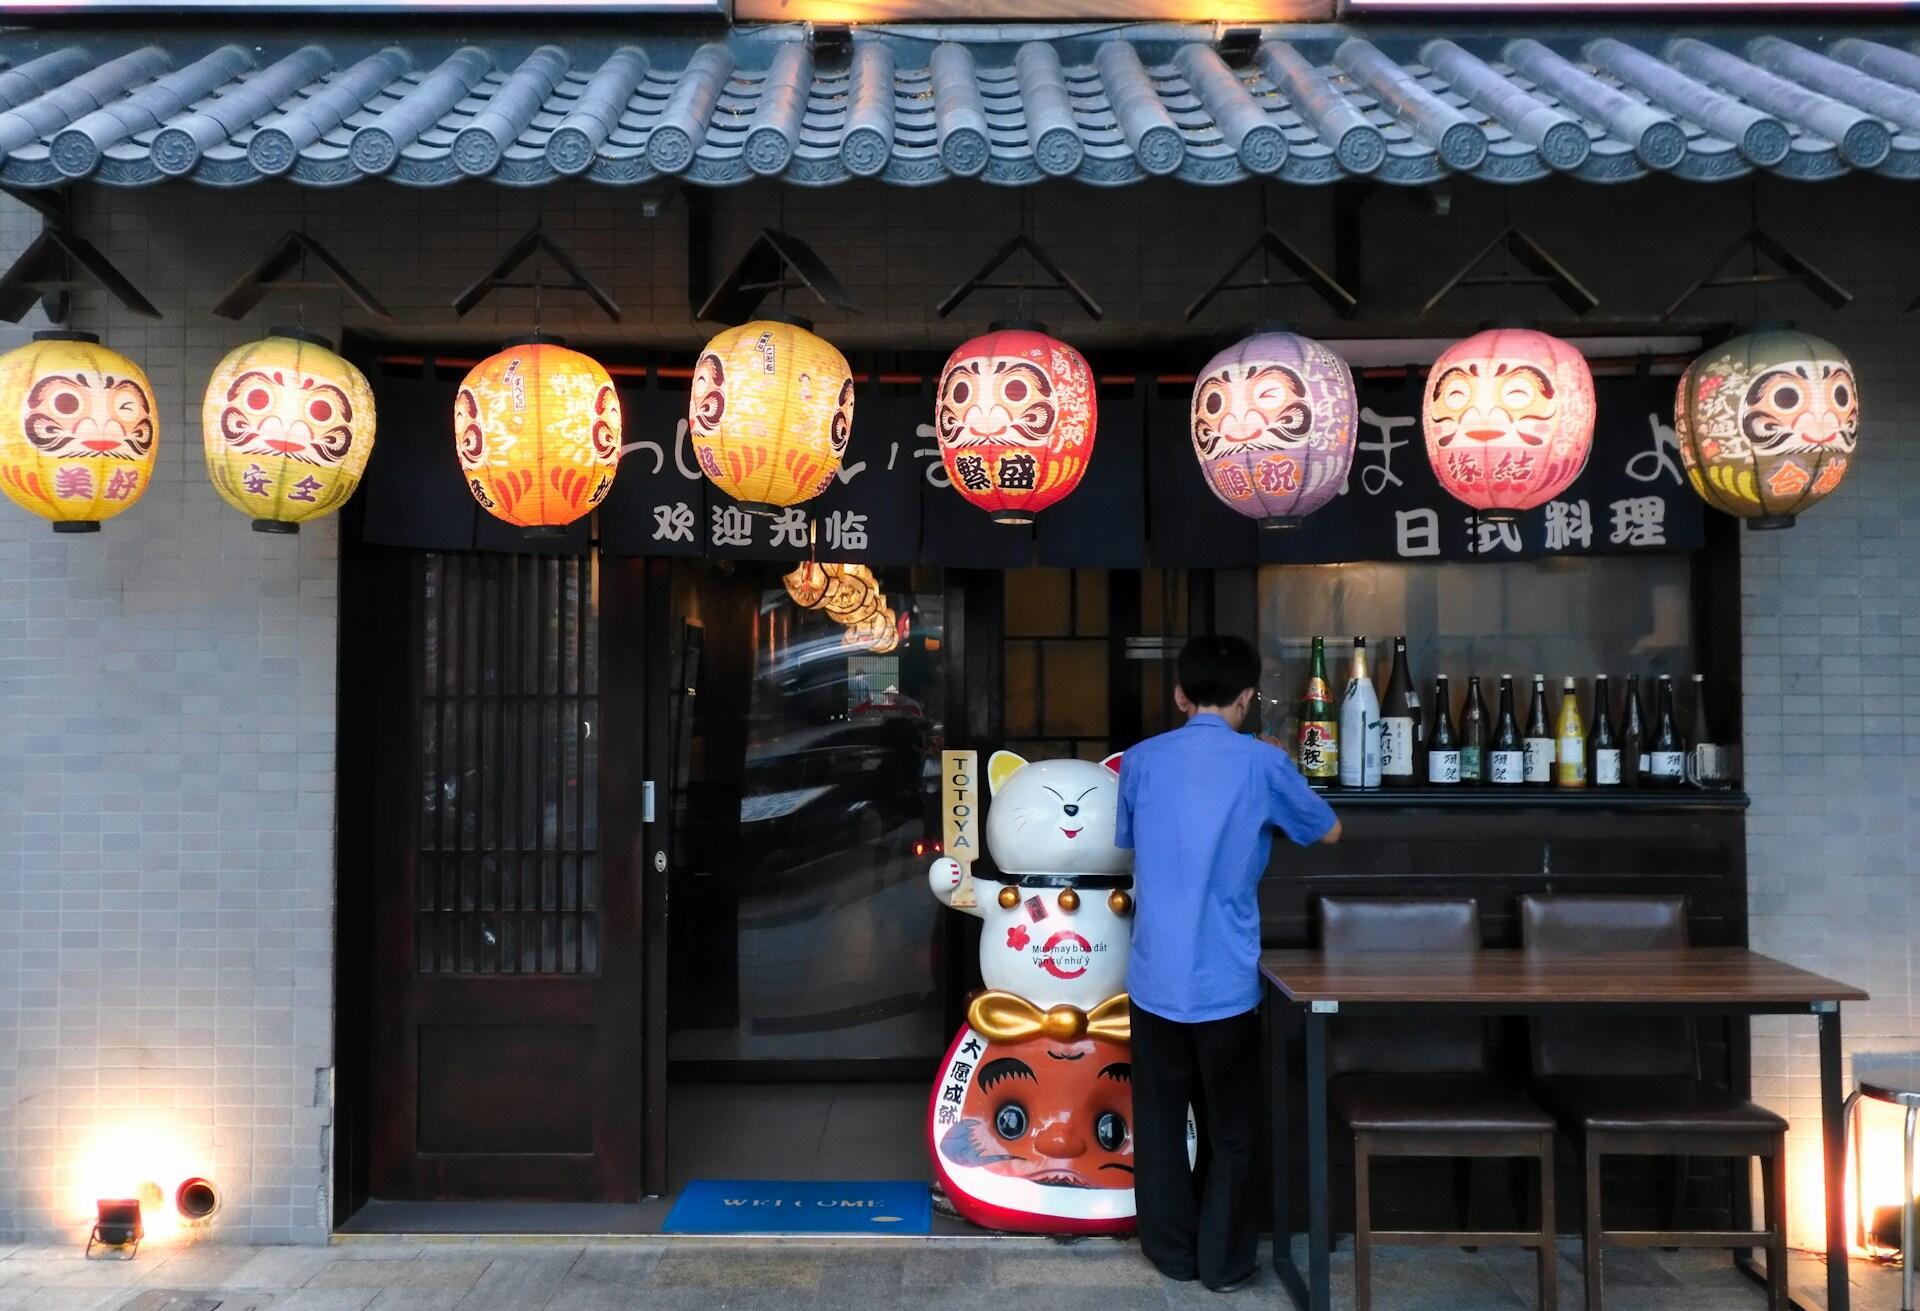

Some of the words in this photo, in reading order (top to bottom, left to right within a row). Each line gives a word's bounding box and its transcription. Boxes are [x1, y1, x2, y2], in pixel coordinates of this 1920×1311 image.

[55, 466, 139, 500] 美好
[242, 463, 323, 502] 安全
[956, 454, 1035, 490] 繁盛
[652, 502, 868, 550] 欢迎光临
[1395, 496, 1666, 557] 日式料理
[952, 758, 970, 848] TOTOYA
[1050, 945, 1071, 954] may
